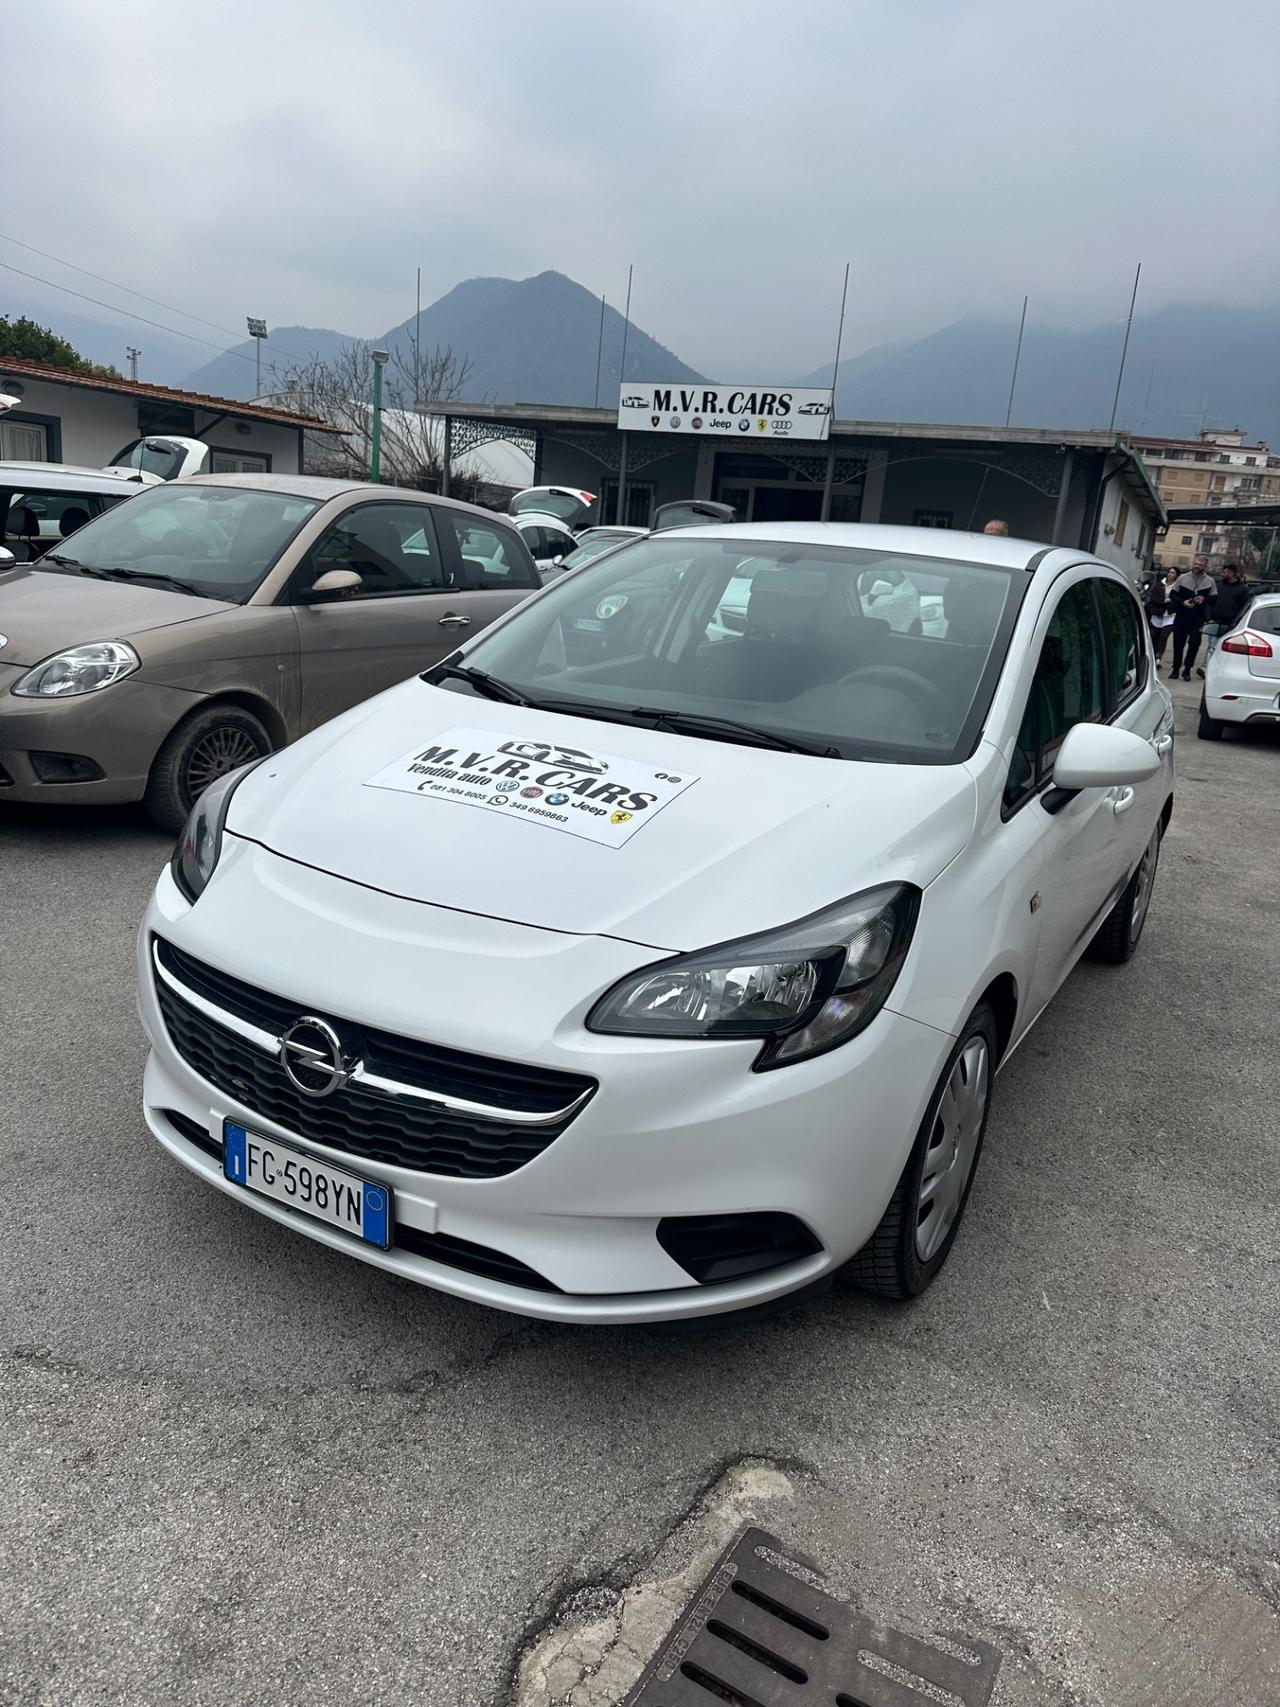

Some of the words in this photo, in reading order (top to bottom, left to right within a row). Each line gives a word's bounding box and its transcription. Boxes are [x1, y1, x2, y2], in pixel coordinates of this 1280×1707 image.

[709, 418, 732, 430] Jeep
[407, 763, 458, 779] Vendita
[457, 771, 493, 786] auto
[429, 784, 447, 792] 081
[447, 787, 463, 795] 304
[509, 801, 527, 811] 349
[571, 801, 608, 817] Jeep
